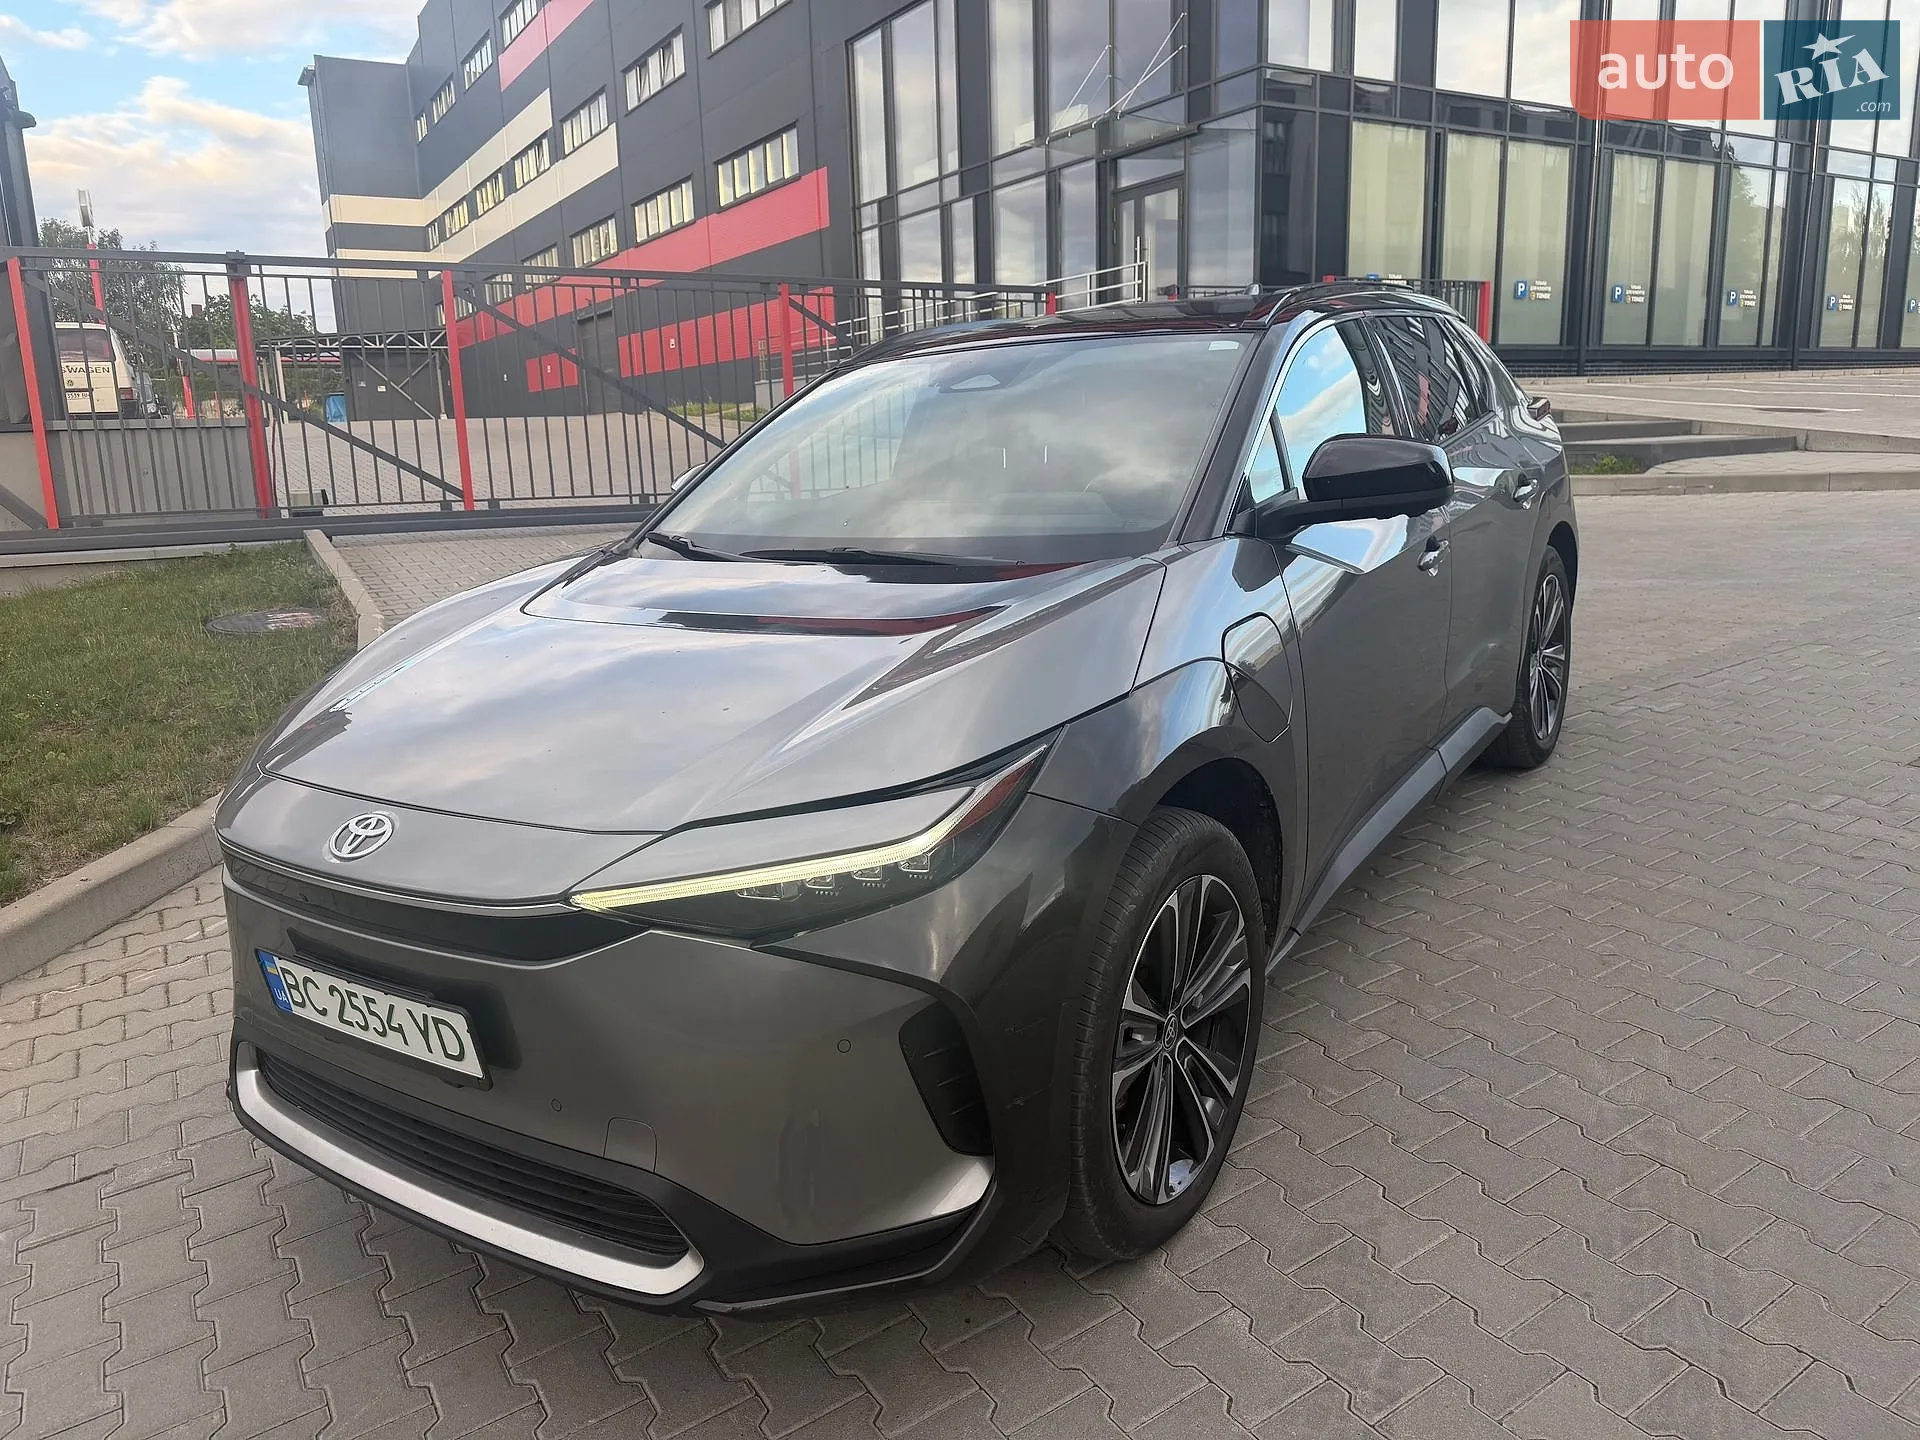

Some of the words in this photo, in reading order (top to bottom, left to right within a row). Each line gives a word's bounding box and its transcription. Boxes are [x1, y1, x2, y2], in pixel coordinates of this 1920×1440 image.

[274, 988, 289, 1004] UA
[279, 966, 328, 1017] BC
[328, 984, 409, 1047] 2554
[406, 1008, 466, 1062] YD
